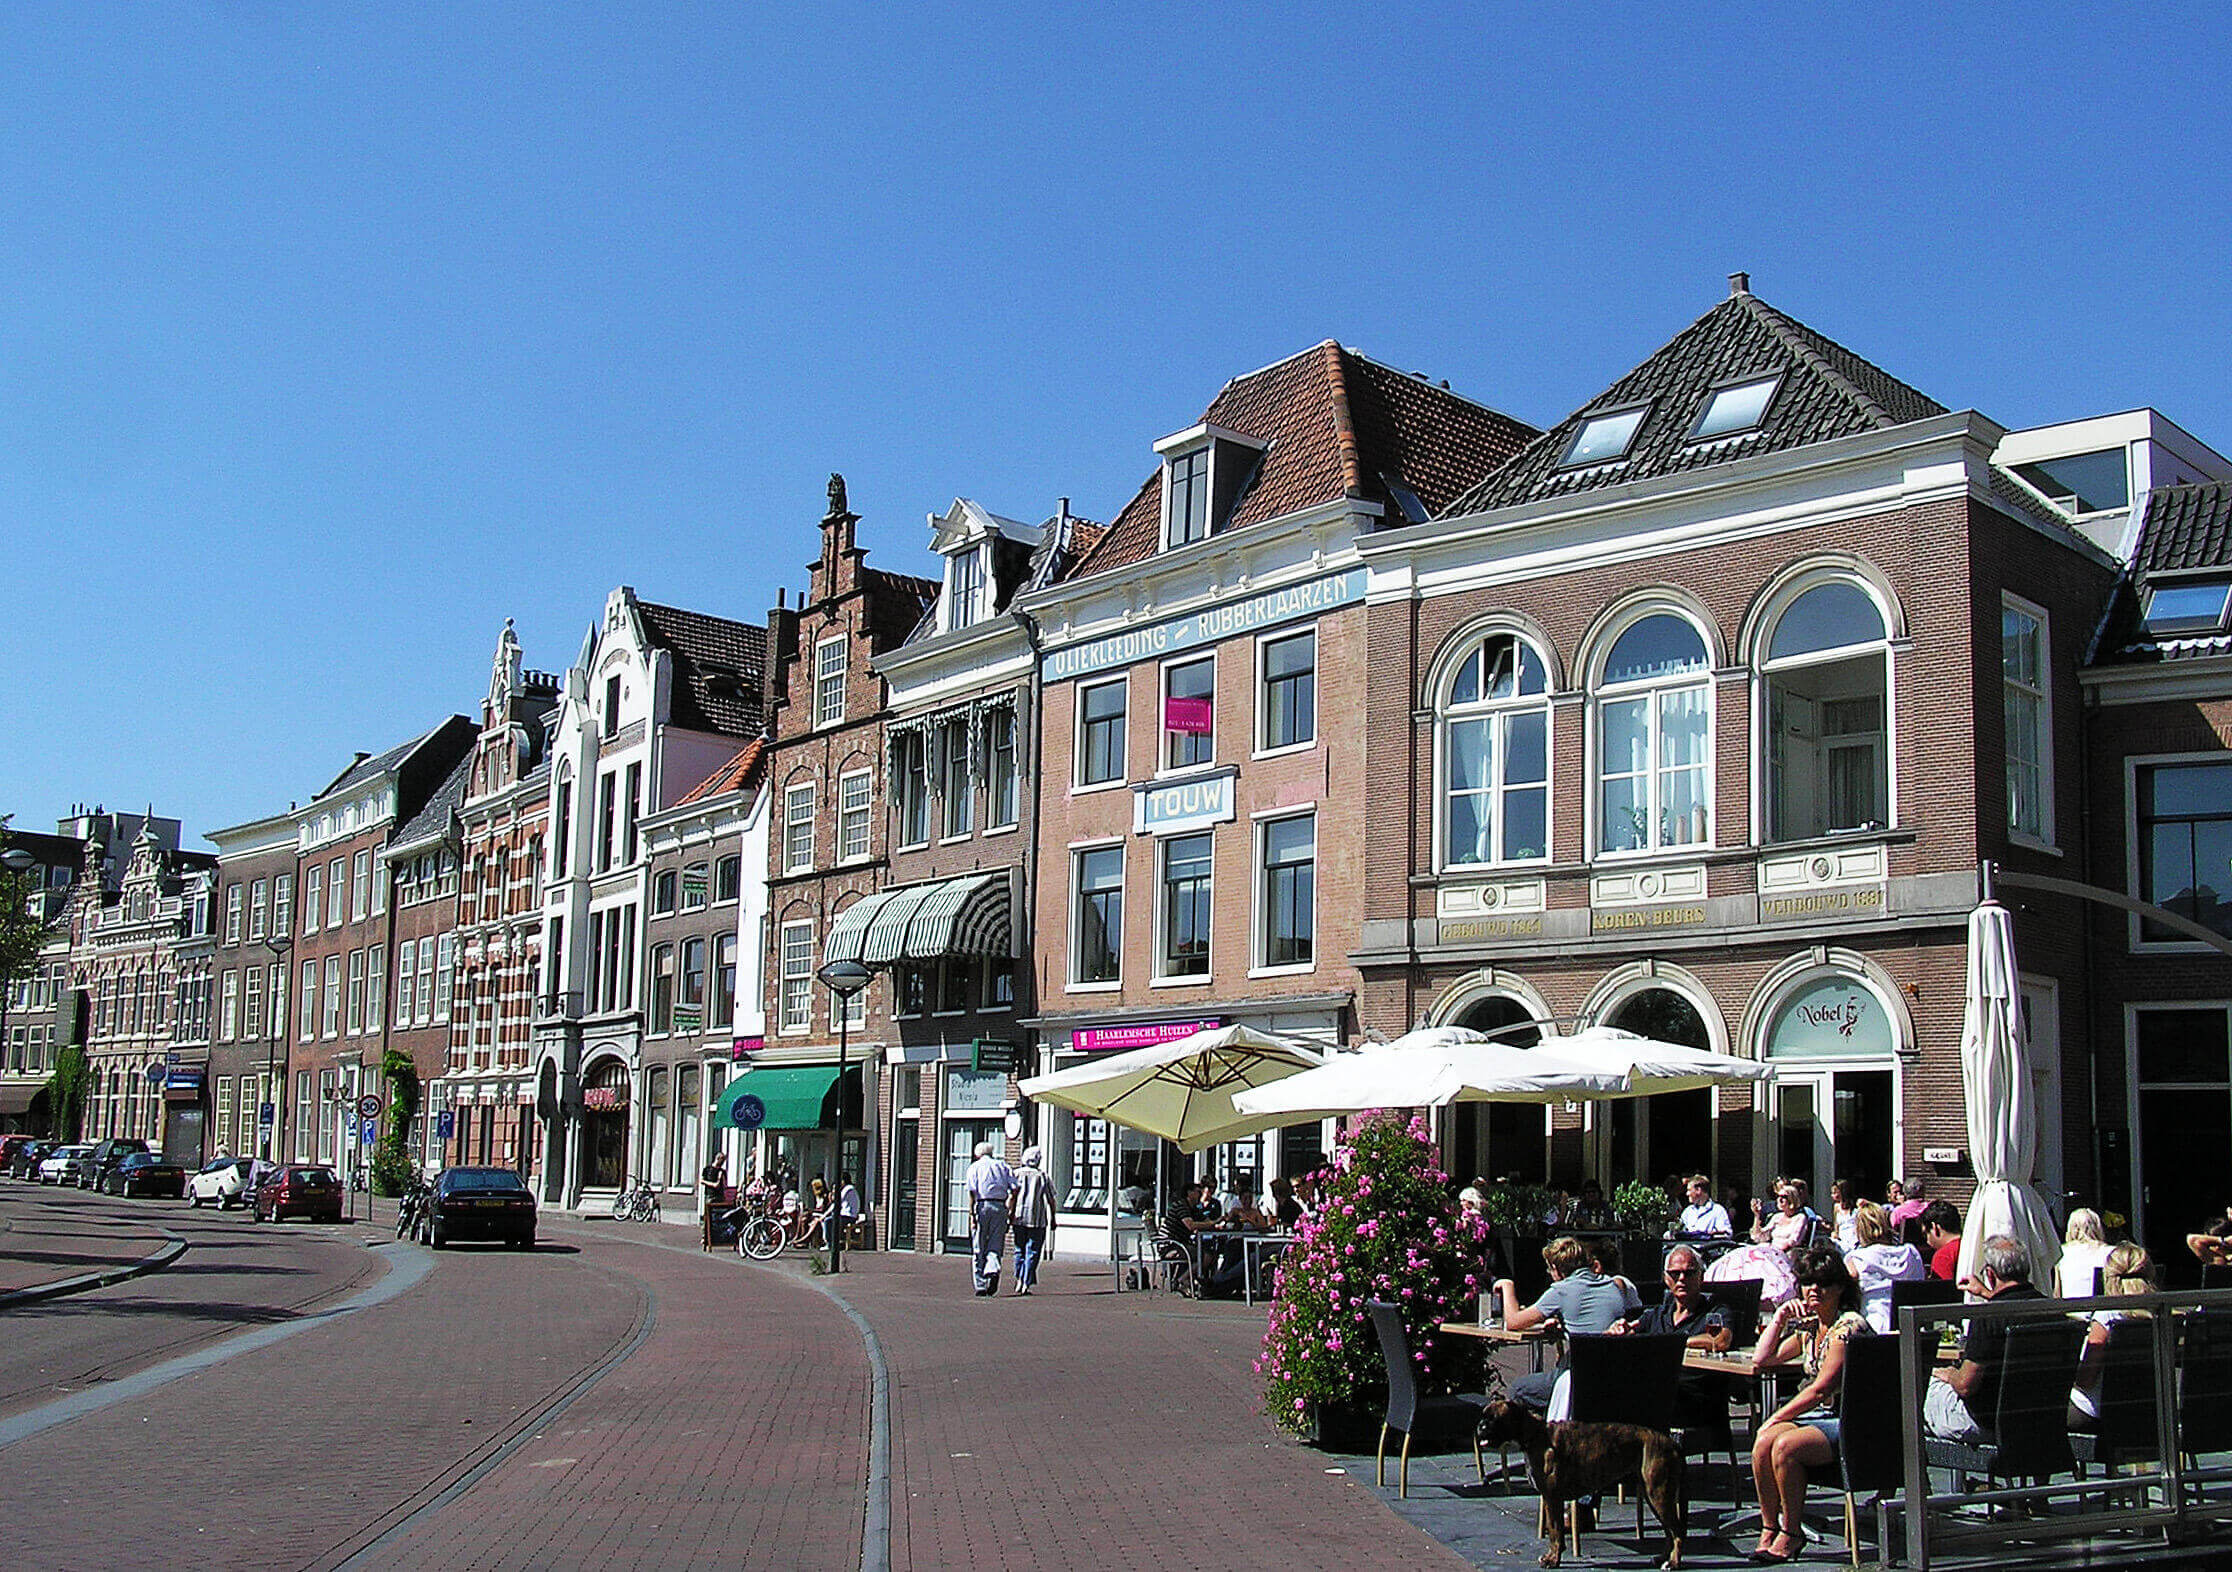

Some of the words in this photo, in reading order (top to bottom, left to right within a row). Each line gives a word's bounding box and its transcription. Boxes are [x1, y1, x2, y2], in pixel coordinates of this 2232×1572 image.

[1198, 575, 1348, 638] RUBBERLAARZEN
[1149, 782, 1221, 818] TOUW
[1763, 892, 1849, 914] VERBOUWD
[1796, 1004, 1842, 1027] Nobel
[362, 1102, 378, 1112] 30
[365, 1121, 372, 1134] P
[441, 1113, 451, 1126] P
